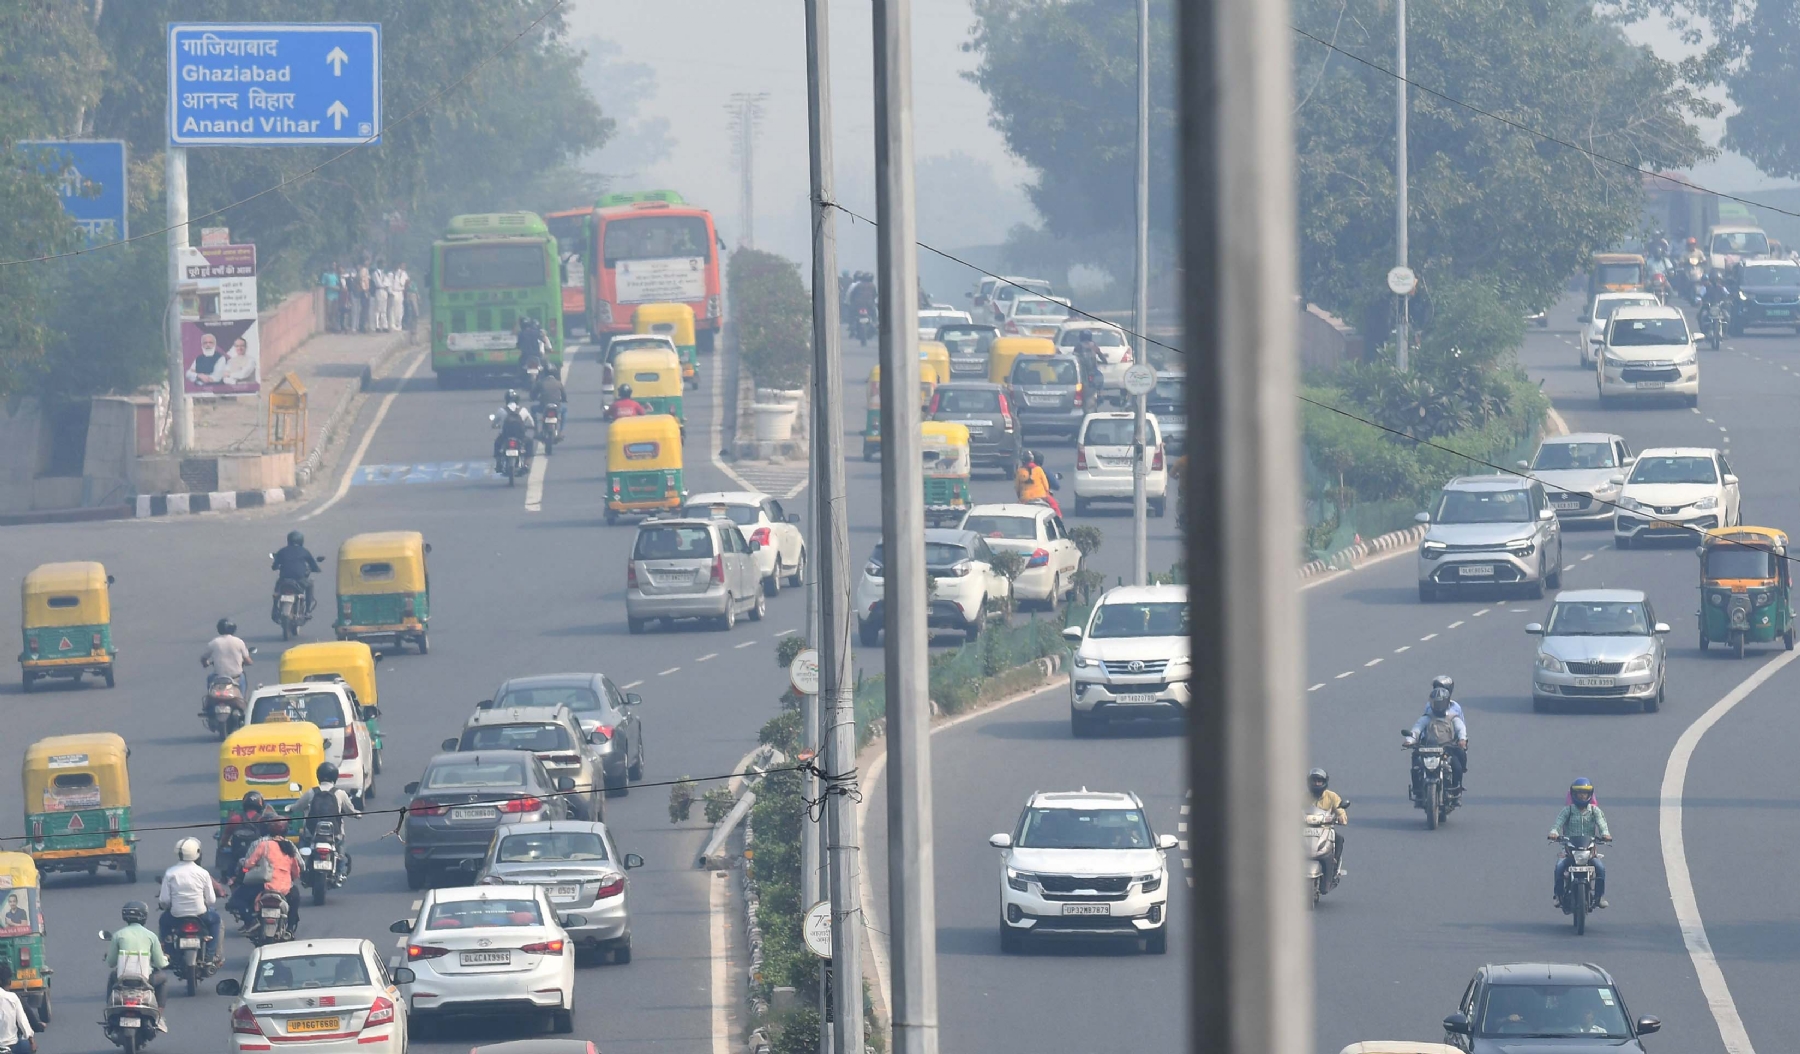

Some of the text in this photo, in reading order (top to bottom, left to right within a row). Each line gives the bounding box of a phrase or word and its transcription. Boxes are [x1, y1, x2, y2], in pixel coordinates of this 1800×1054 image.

[181, 32, 279, 57] गाजियाबाद
[182, 65, 291, 82] Ghaziabad
[182, 87, 296, 112] आनन्द विहार
[183, 116, 321, 133] Anand Vihar
[258, 743, 277, 752] NCR
[291, 1019, 338, 1030] UP16GT6680
